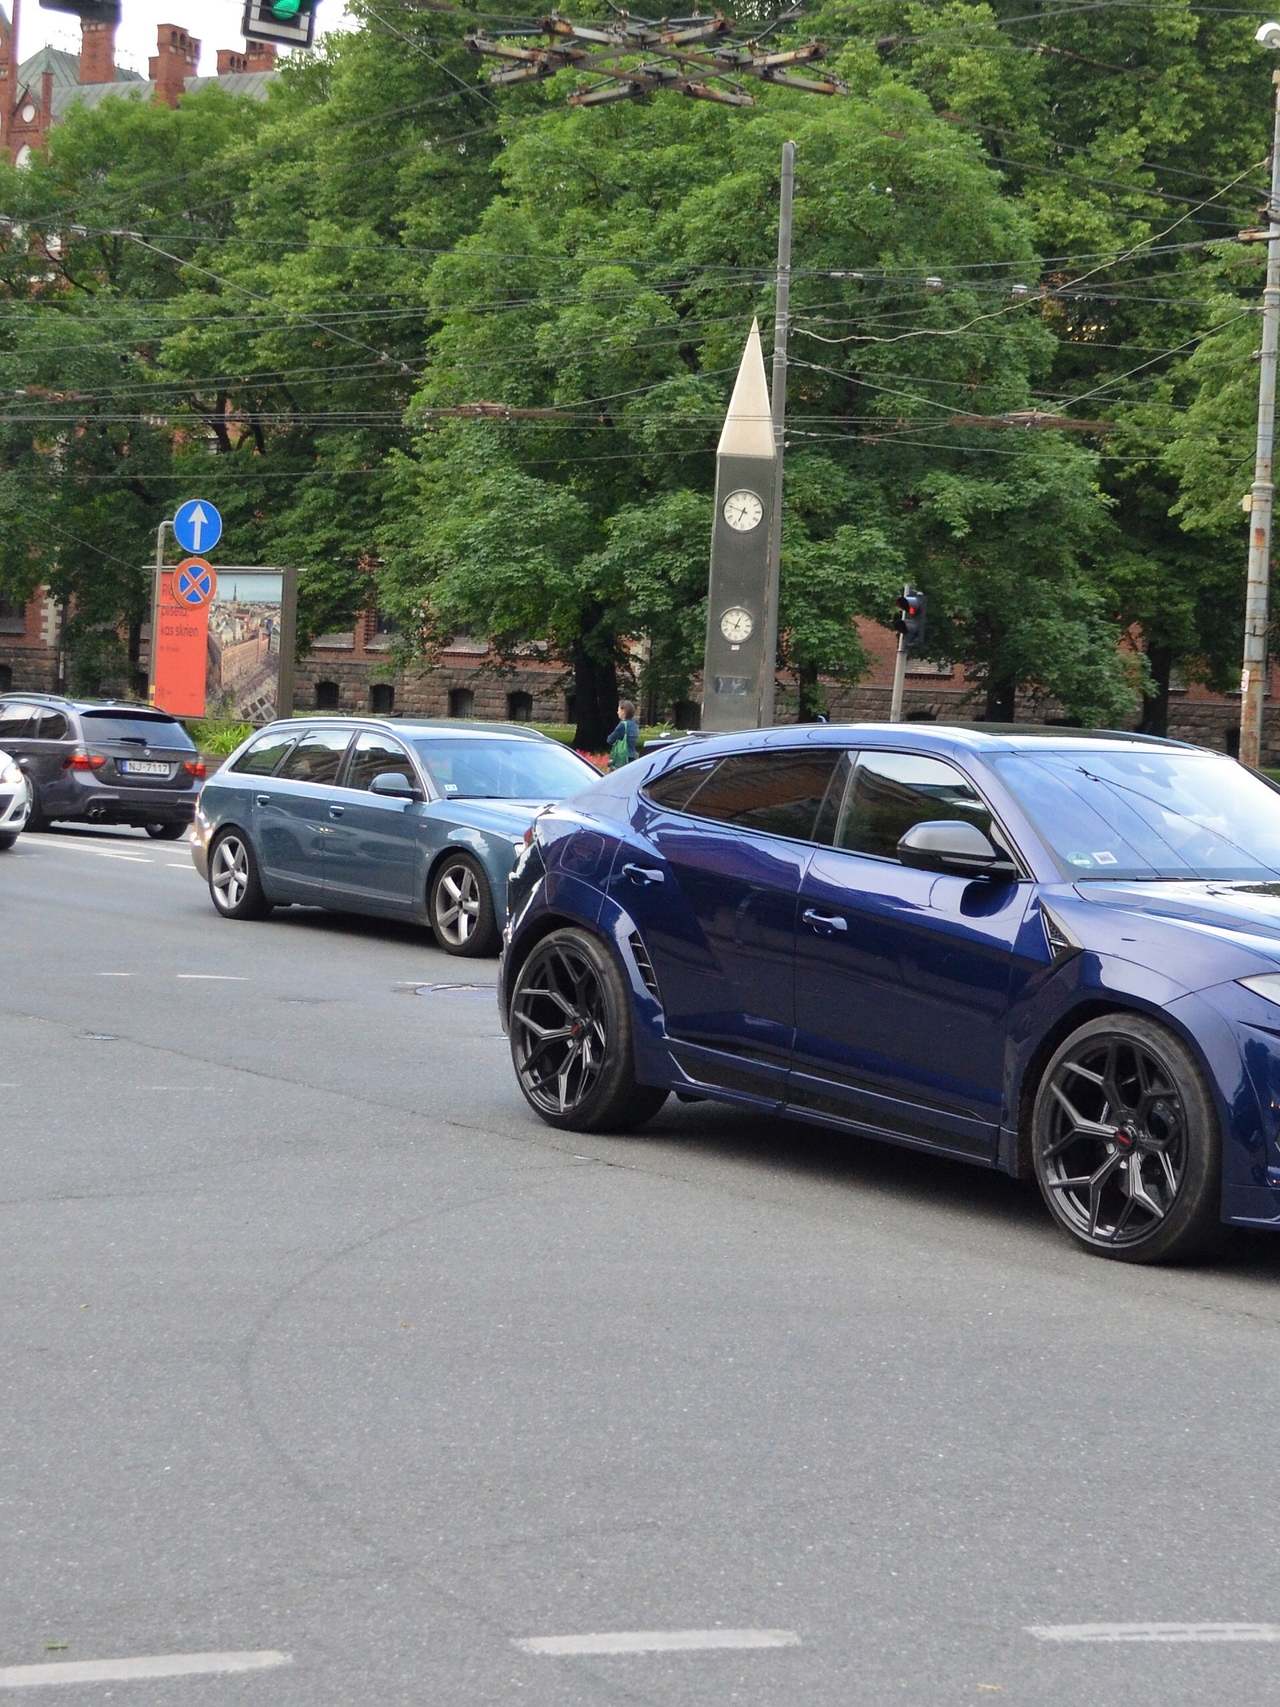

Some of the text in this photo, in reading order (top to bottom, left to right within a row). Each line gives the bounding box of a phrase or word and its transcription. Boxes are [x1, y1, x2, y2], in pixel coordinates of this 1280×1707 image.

[161, 622, 198, 638] kas skrien
[128, 762, 168, 773] NJ-7117
